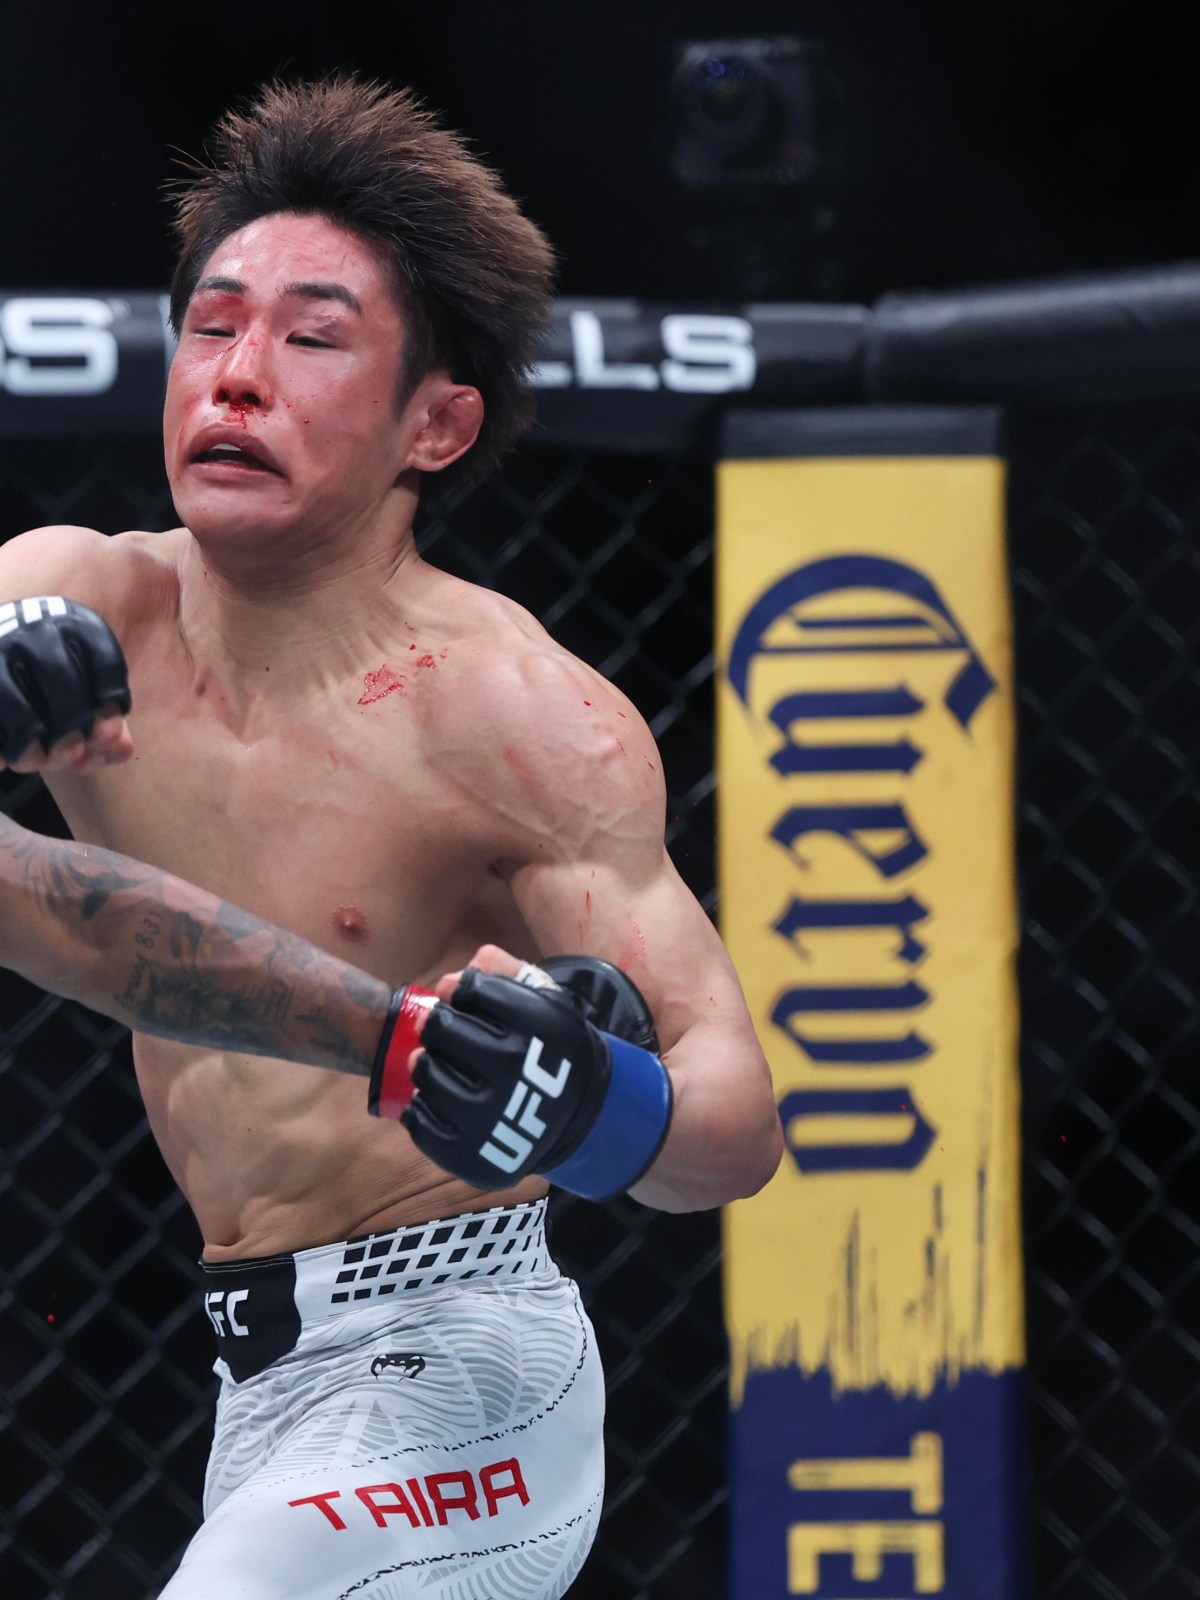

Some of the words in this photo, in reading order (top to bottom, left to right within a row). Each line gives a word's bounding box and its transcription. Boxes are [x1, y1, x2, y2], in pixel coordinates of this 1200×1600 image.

[726, 553, 998, 1174] Cuervo
[479, 1036, 572, 1174] UFC
[288, 1457, 531, 1531] TAIRA
